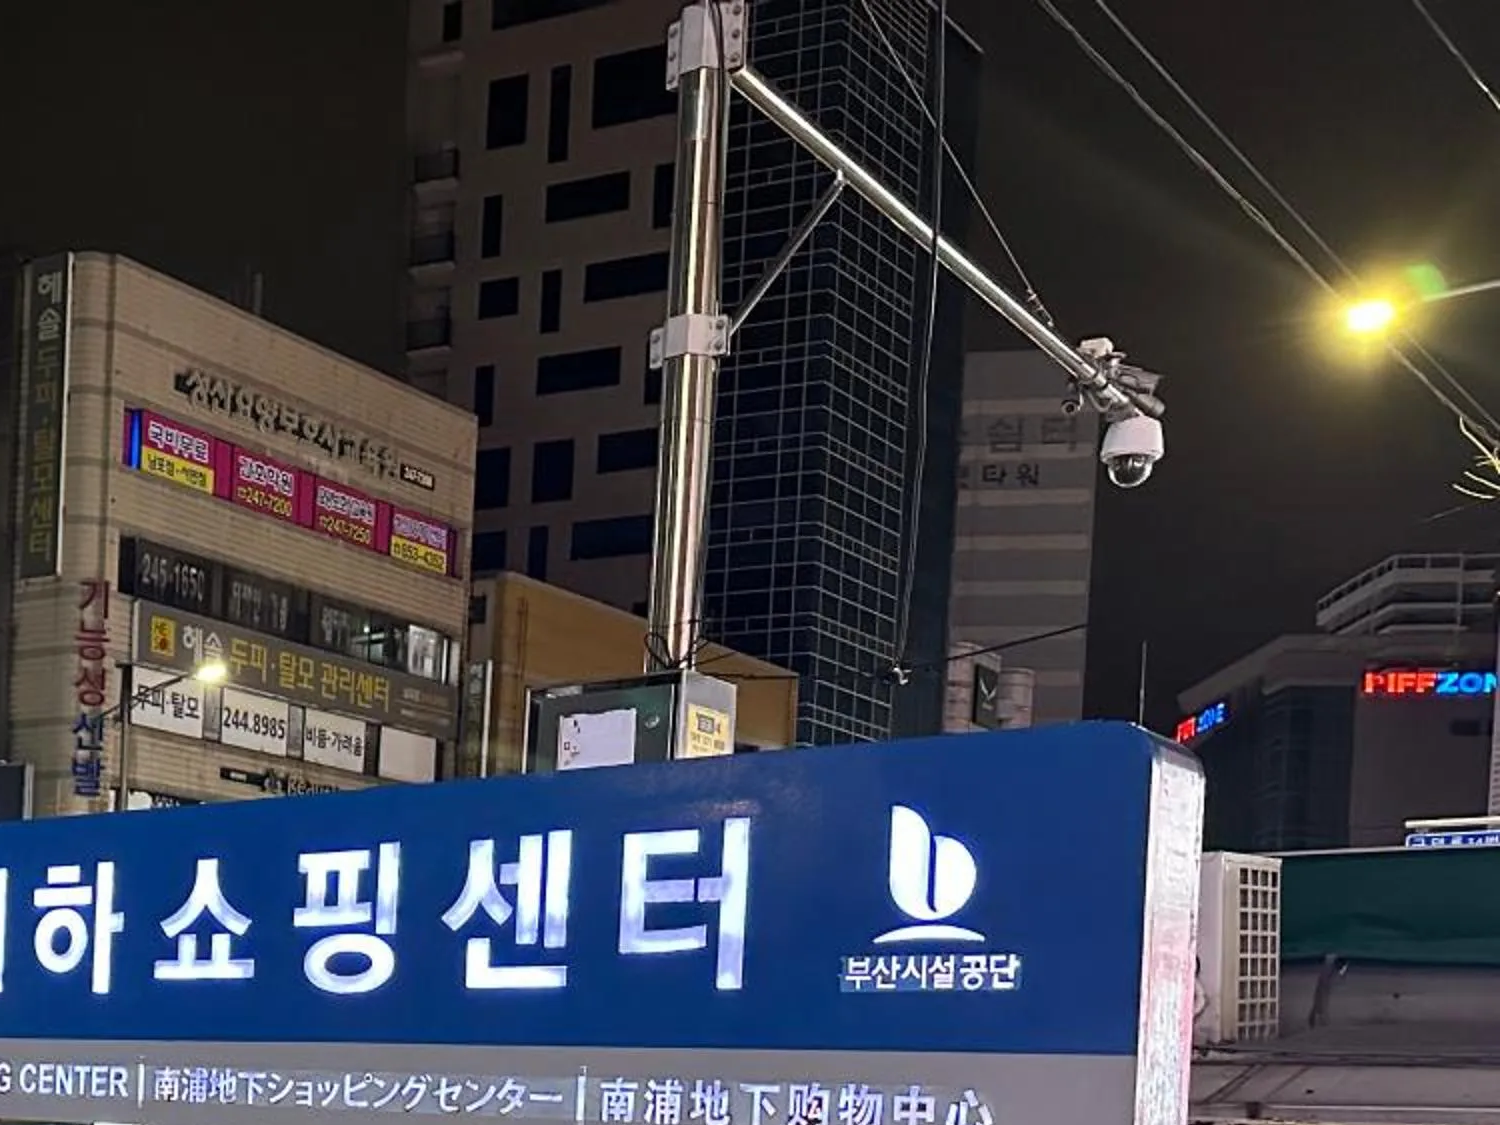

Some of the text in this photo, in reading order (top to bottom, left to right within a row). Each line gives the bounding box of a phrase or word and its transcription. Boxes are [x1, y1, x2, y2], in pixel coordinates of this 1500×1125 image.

[72, 580, 110, 797] 기능성 신발
[230, 638, 315, 691] 두피·탈모
[321, 661, 391, 714] 관리센터
[223, 706, 286, 741] 244.8985
[843, 953, 1021, 991] 부산시설공단
[18, 1063, 129, 1099] CENTER
[153, 1066, 563, 1116] 南浦地下ショッピングセンター
